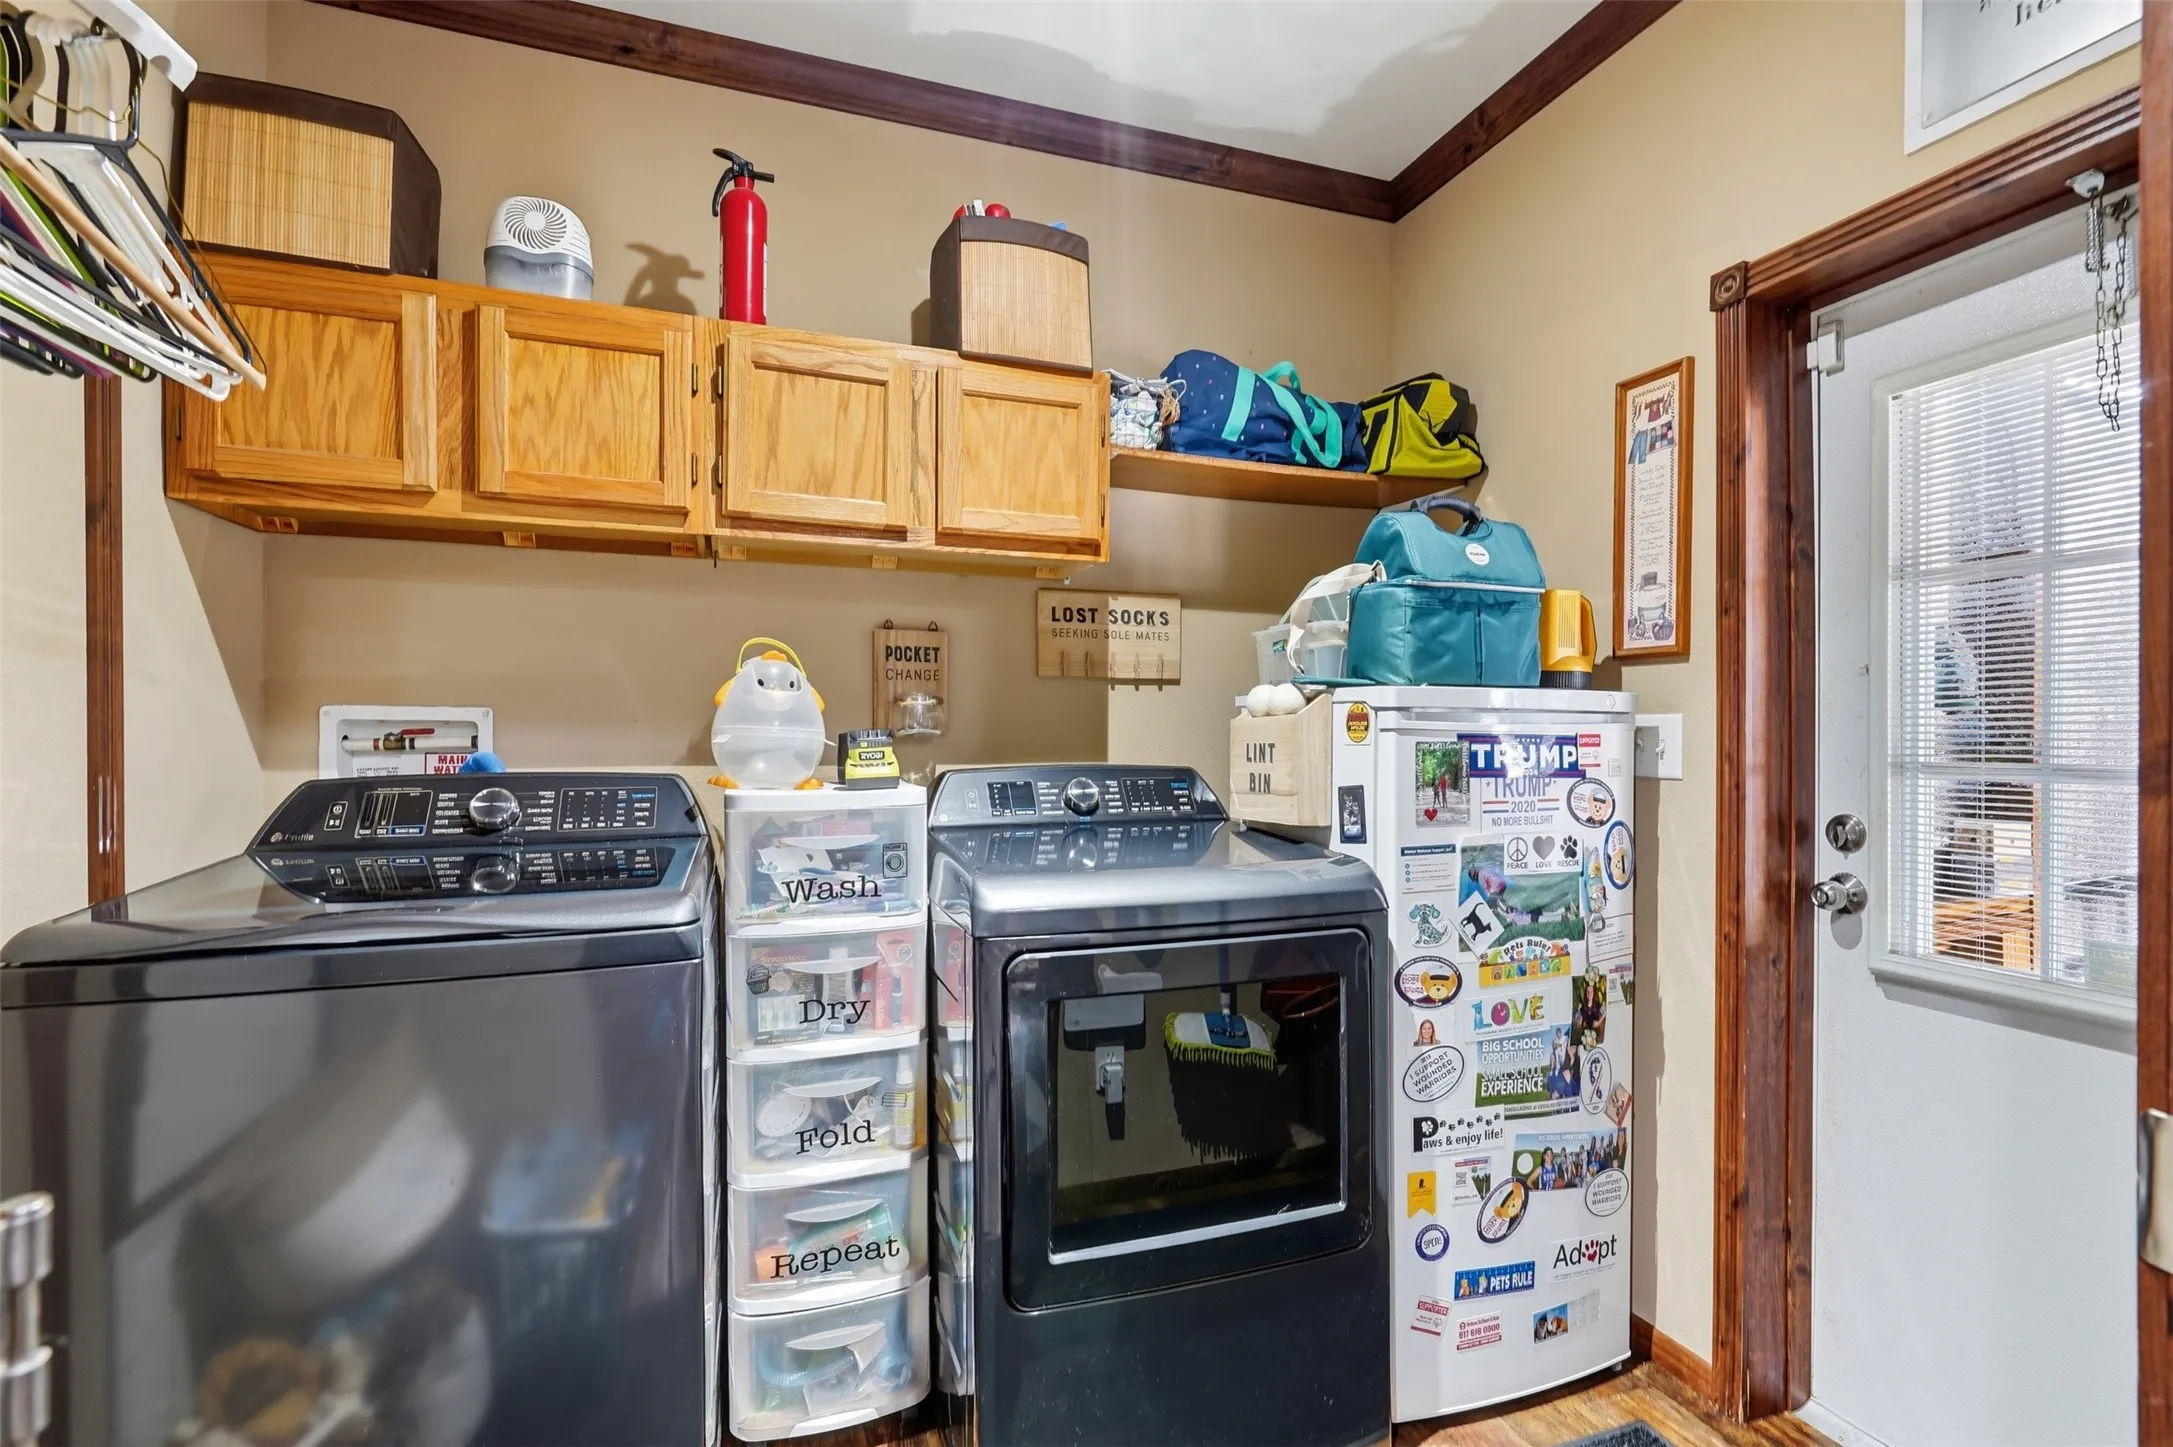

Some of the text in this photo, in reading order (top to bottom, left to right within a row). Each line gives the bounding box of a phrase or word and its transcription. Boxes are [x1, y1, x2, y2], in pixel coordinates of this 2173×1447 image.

[1051, 606, 1170, 626] LOST SOCKS
[1052, 628, 1170, 641] SEEKING SOLE MATES
[885, 645, 940, 663] POCKET
[885, 668, 940, 681] CHANGE
[860, 752, 884, 760] RYOBI
[1246, 743, 1276, 763] LINT
[1470, 743, 1577, 768] TRUMP
[1249, 772, 1271, 794] BIN
[1494, 777, 1551, 798] TRUMP
[1511, 801, 1536, 813] 2020
[1491, 815, 1553, 827] NO MORE BULLSHIT
[781, 875, 882, 903] Wash
[1503, 942, 1524, 956] Pets
[799, 999, 871, 1024] Dry
[1472, 994, 1544, 1031] LOVE
[1482, 1038, 1544, 1052] BIG SCHOOL
[1414, 1051, 1448, 1077] SUPPORT
[1482, 1049, 1544, 1064] OPPORTUNITIES
[1413, 1059, 1452, 1087] WOUNDED
[1416, 1066, 1456, 1094] WARRIORS
[1511, 1065, 1543, 1079] SCHOOL
[1481, 1078, 1543, 1097] EXPERIENCE
[795, 1120, 876, 1155] Fold
[1446, 1136, 1453, 1145] &
[1455, 1132, 1482, 1146] enjoy
[1484, 1128, 1504, 1140] life!
[770, 1235, 900, 1279] Repeat
[1490, 1271, 1533, 1292] PETS RULE
